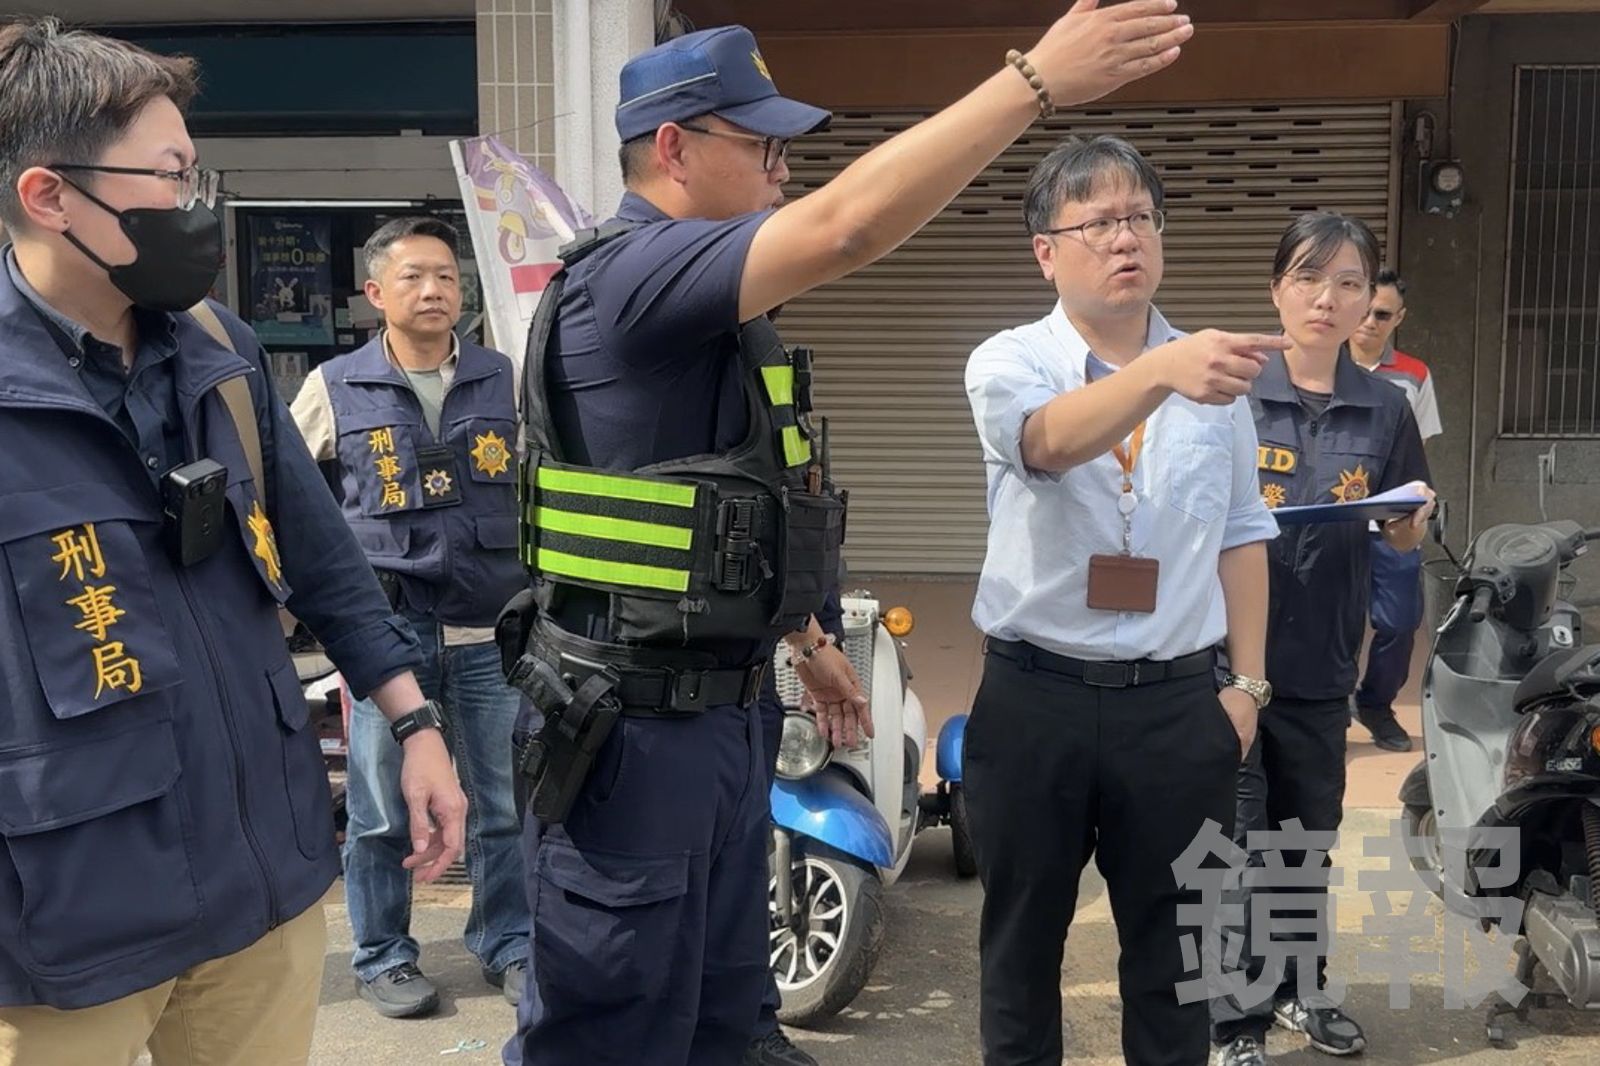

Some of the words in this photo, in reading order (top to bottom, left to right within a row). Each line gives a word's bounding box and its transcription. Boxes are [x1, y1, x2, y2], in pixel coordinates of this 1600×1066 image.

[368, 427, 406, 509] 刑事局
[1257, 446, 1296, 472] ID
[51, 522, 143, 700] 刑事局
